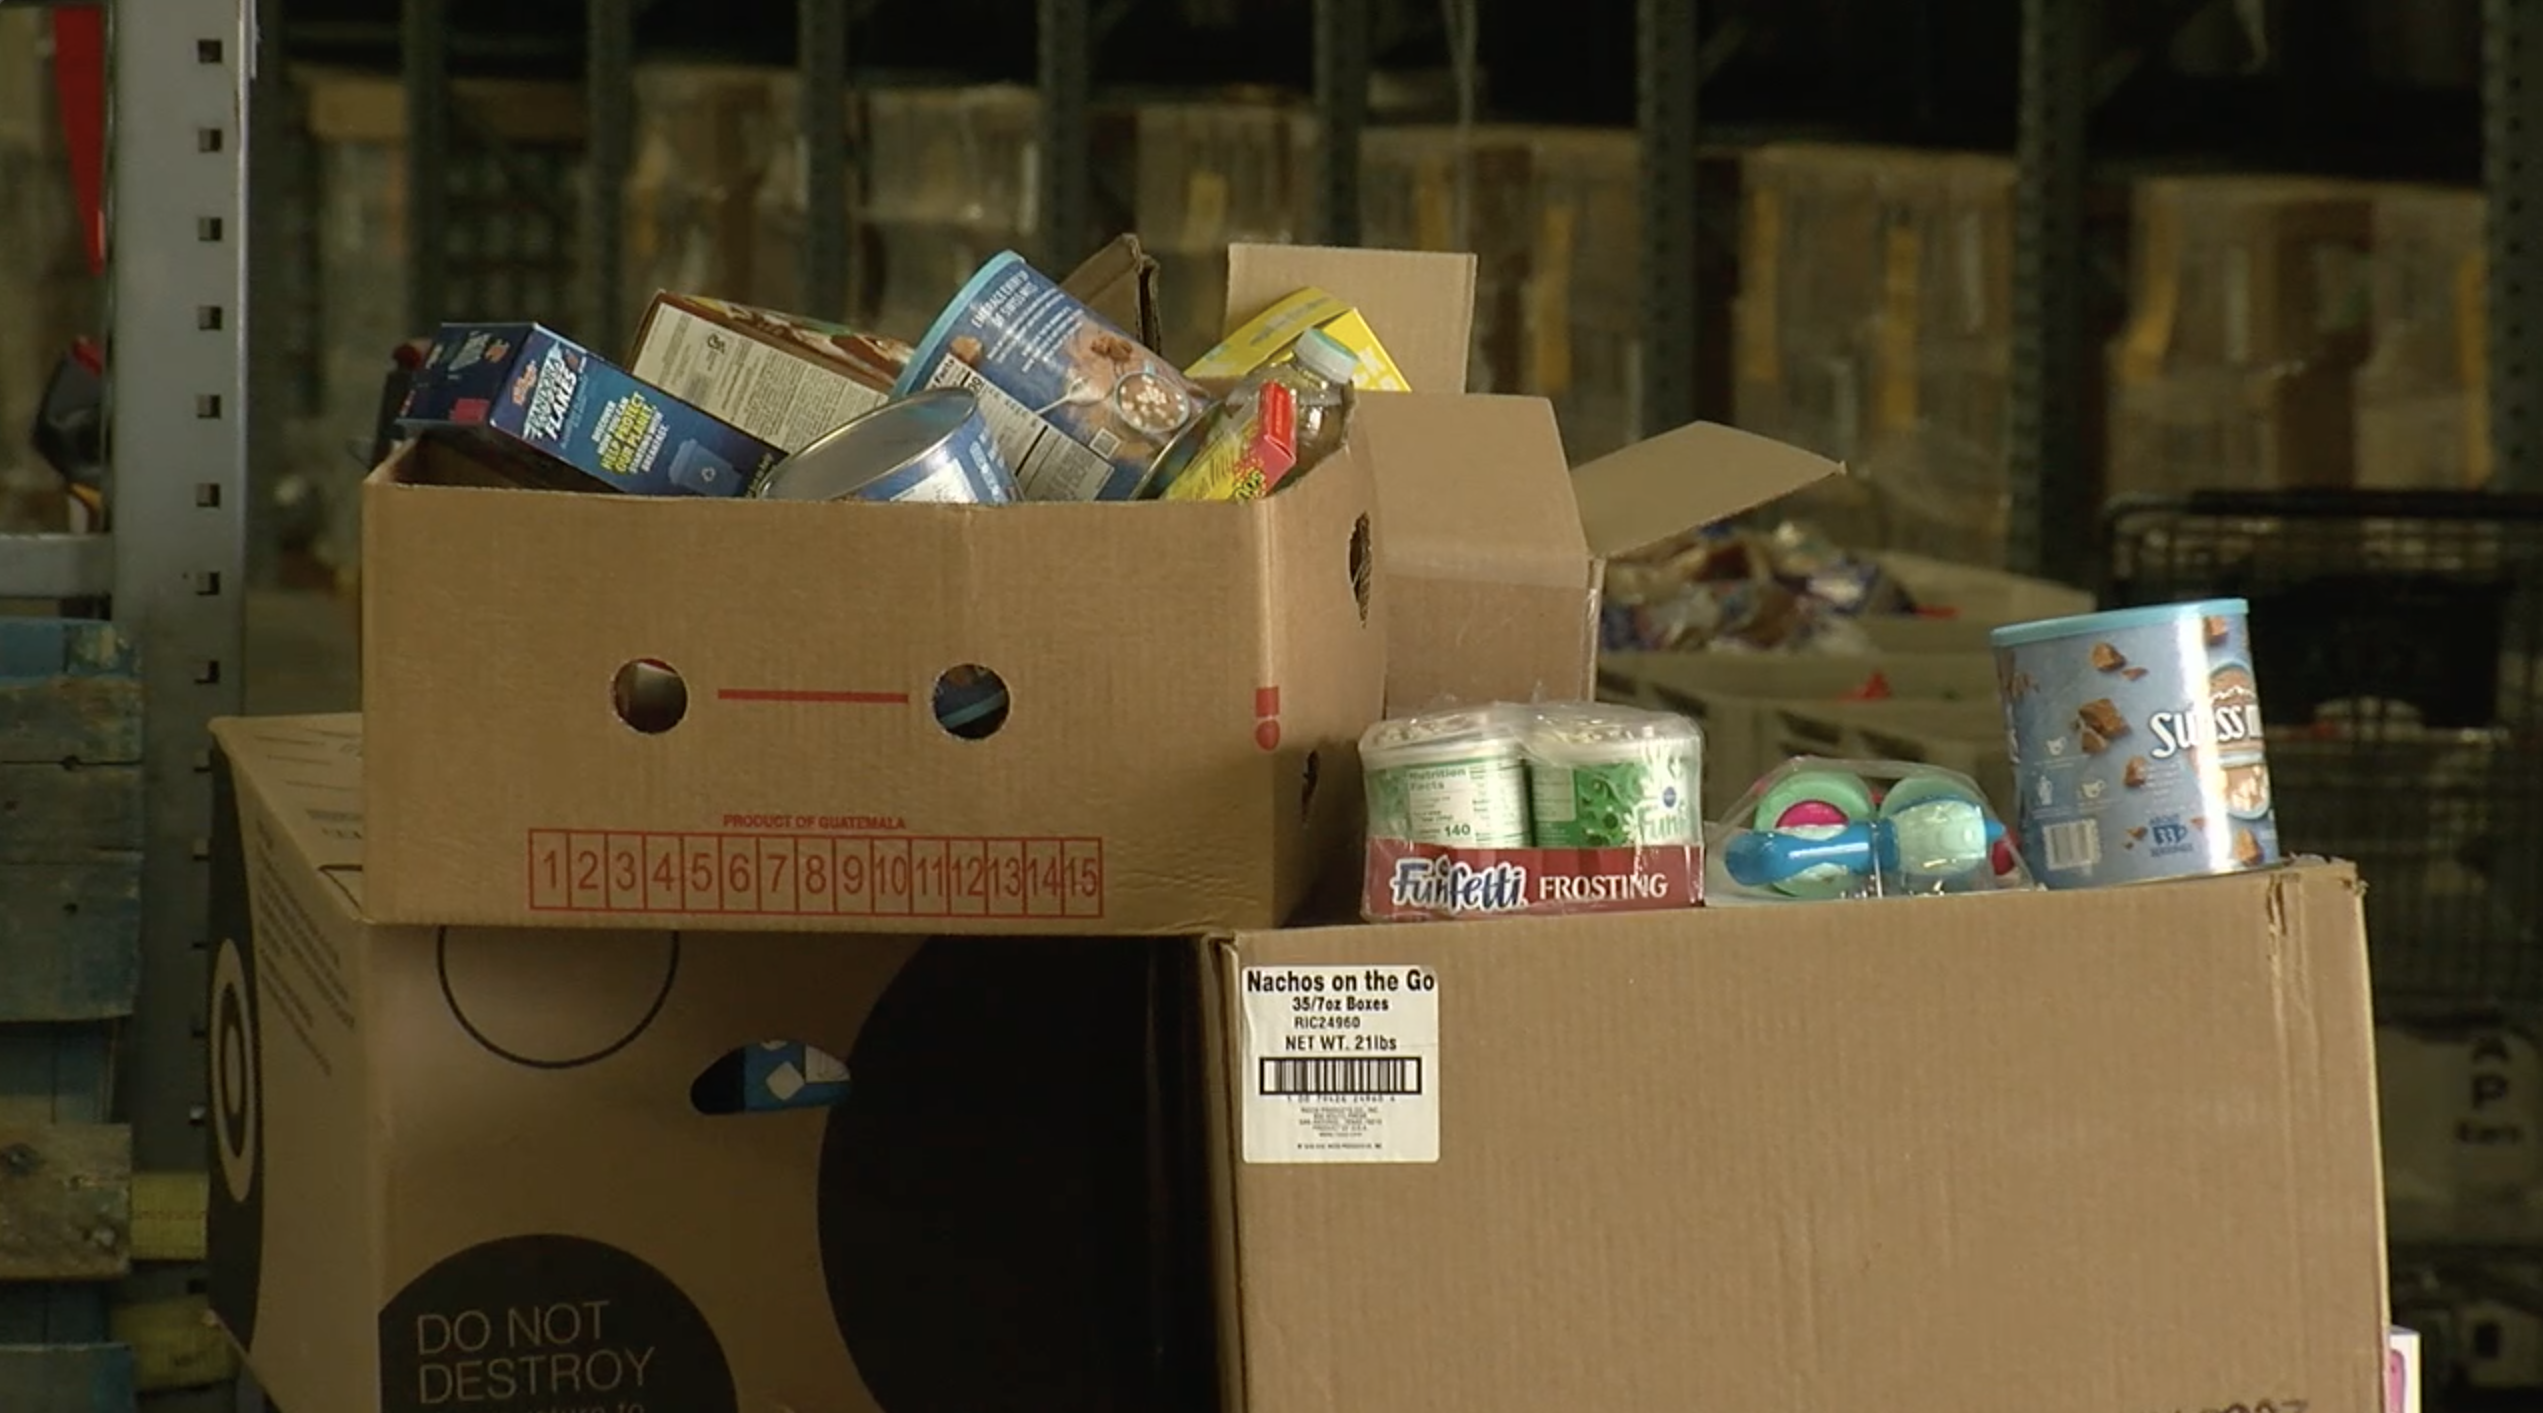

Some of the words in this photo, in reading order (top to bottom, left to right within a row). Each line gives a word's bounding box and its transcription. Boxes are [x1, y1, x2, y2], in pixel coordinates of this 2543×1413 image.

[545, 369, 577, 440] FLAKES
[601, 439, 622, 470] HELP
[614, 393, 646, 442] PROTECT
[614, 446, 635, 473] OUR
[2150, 704, 2244, 759] Swss
[1408, 767, 1466, 780] Nutrition
[1410, 781, 1445, 791] Facts
[723, 814, 791, 829] PRODUCT
[796, 816, 816, 829] OF
[819, 816, 906, 831] GUATEMALA
[1444, 823, 1471, 837] 140
[543, 851, 558, 889] 1
[578, 851, 598, 890] 2
[616, 852, 635, 891] 3
[652, 852, 675, 891] 4
[692, 853, 712, 892] 5
[730, 853, 749, 892] 6
[767, 854, 788, 893] 7
[806, 855, 826, 894] 8
[844, 855, 863, 894] 9
[877, 855, 908, 895] 10
[915, 857, 945, 896] 11
[952, 857, 984, 897] 12
[989, 857, 1022, 897] 13
[1027, 857, 1059, 898] 14
[1064, 857, 1098, 899] 15
[1391, 858, 1527, 912] Funfetti
[1539, 873, 1668, 900] FROSTING
[1247, 970, 1325, 992] Nachos
[1332, 975, 1357, 991] on
[1365, 970, 1399, 991] the
[1406, 969, 1435, 991] Go
[1292, 997, 1341, 1012] 35/7oz
[1346, 997, 1389, 1011] Boxes
[1294, 1016, 1361, 1029] RIC24960
[1285, 1035, 1314, 1050] NET
[1320, 1035, 1351, 1051] WT.
[1355, 1035, 1397, 1050] 21lbs
[417, 1309, 490, 1355] DO
[509, 1300, 610, 1348] NOT
[419, 1346, 655, 1405] DESTROY
